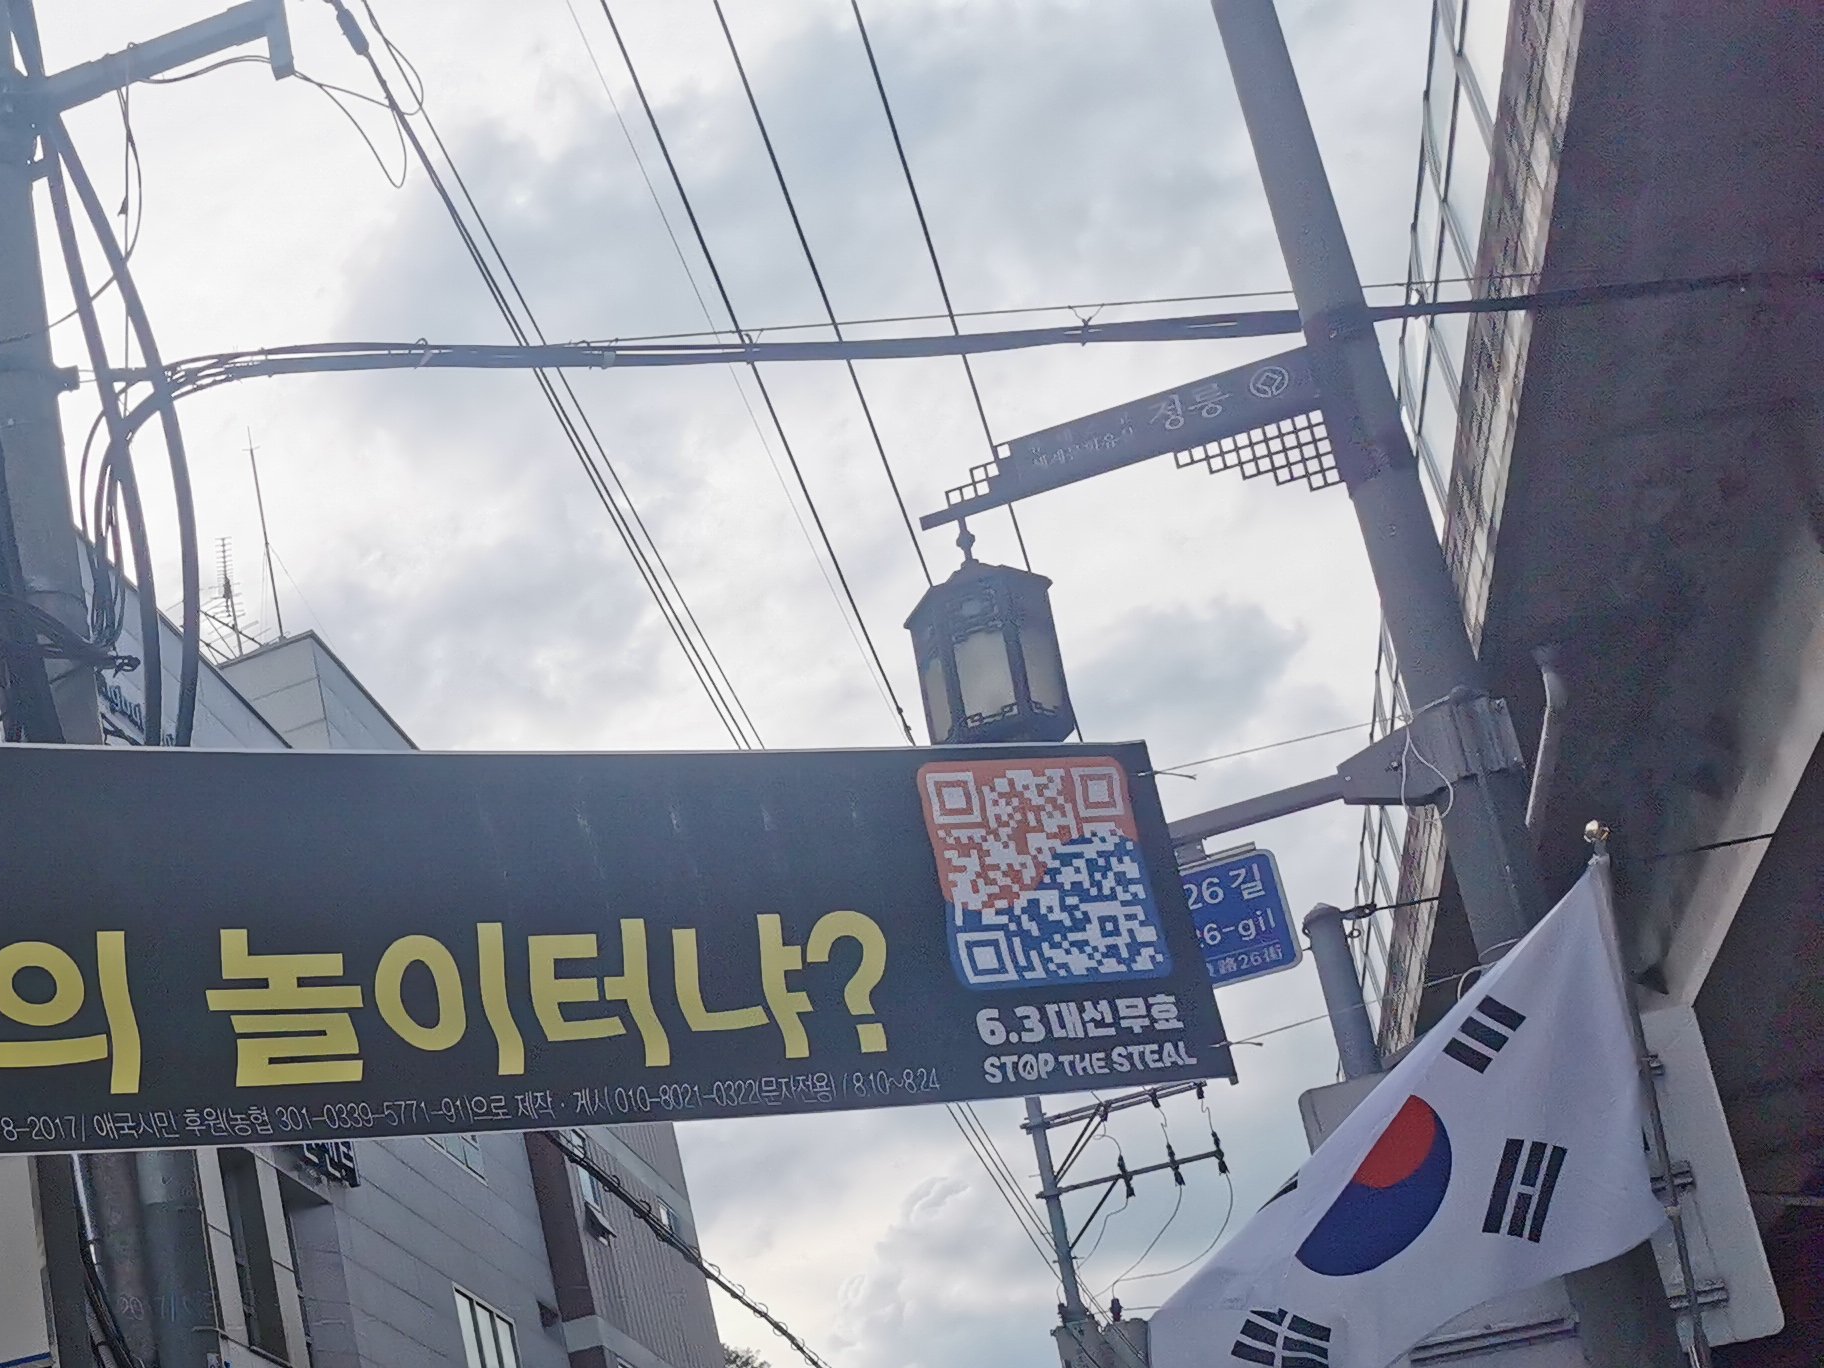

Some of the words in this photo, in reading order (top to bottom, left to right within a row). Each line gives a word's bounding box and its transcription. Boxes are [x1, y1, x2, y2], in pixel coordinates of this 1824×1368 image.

[1196, 907, 1276, 949] 6-gil
[205, 909, 888, 1088] 놀이터냐?
[983, 1053, 1058, 1085] STOP
[1058, 1051, 1110, 1078] THE
[1111, 1040, 1198, 1073] STEAL
[93, 1108, 180, 1141] 애국시민
[514, 1088, 557, 1121] 제작
[573, 1086, 613, 1117] 게시
